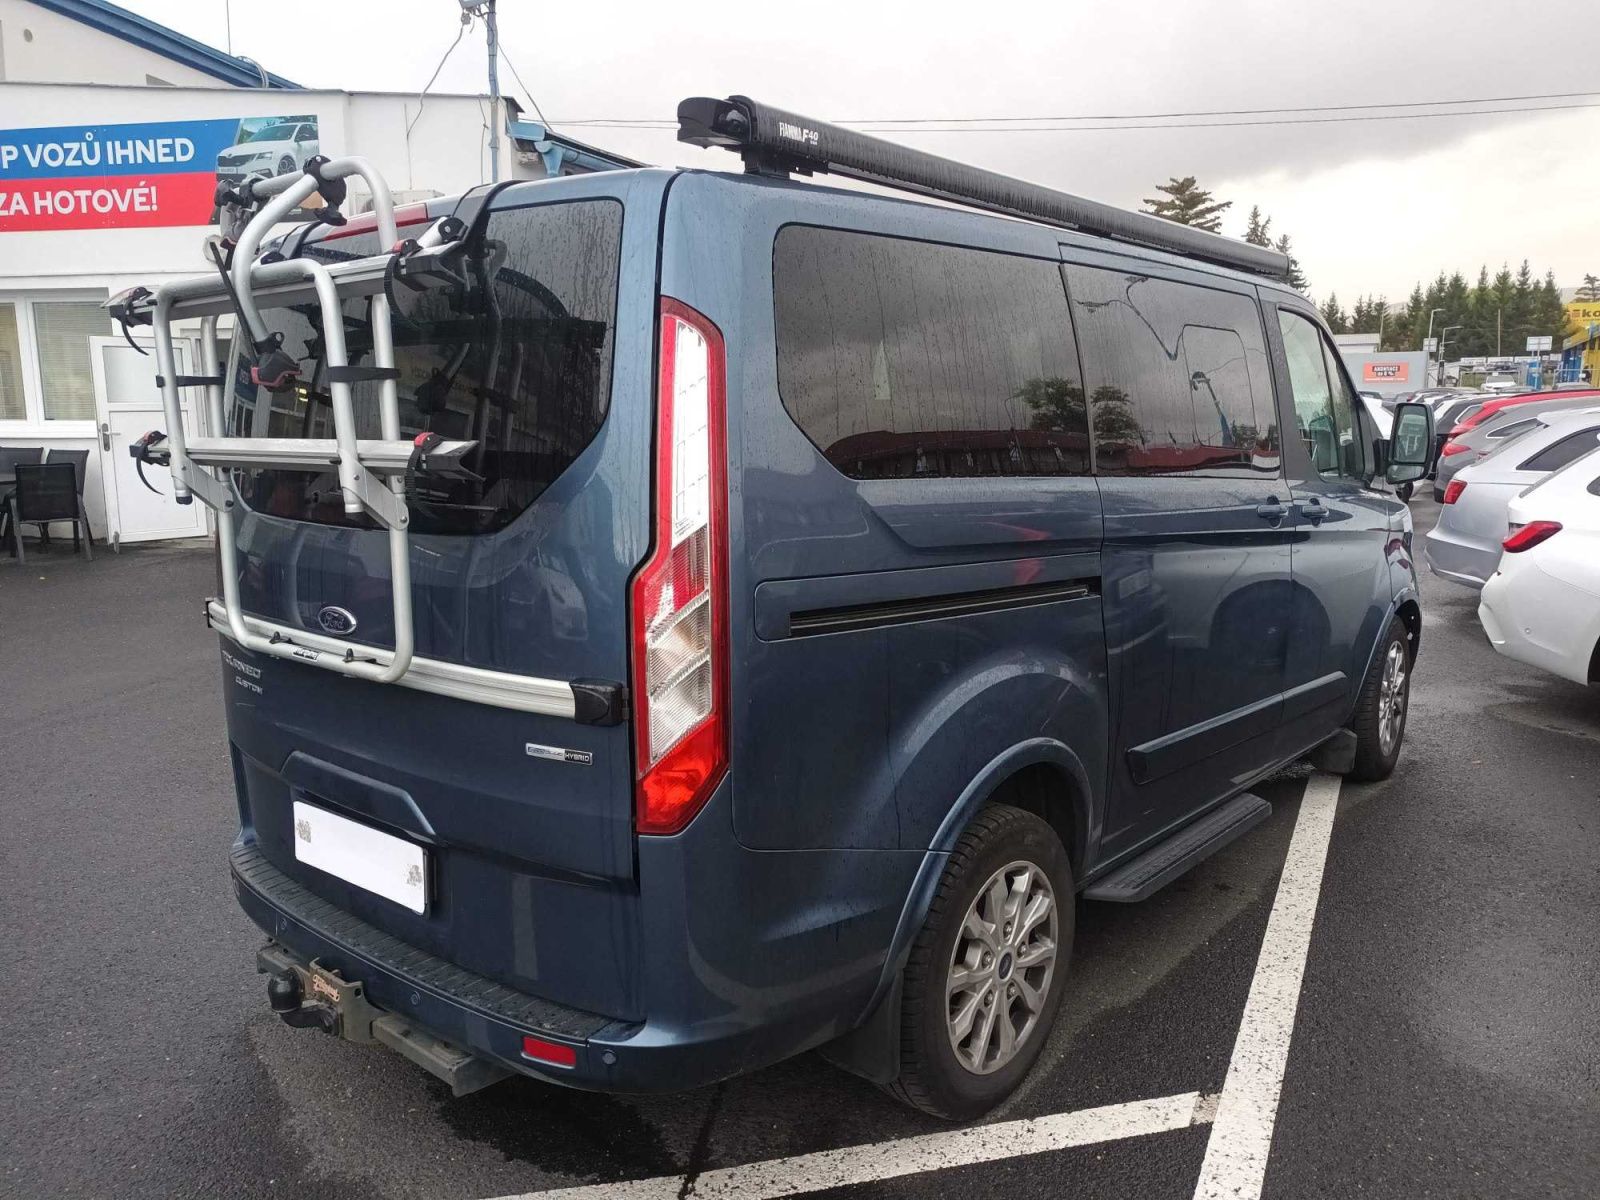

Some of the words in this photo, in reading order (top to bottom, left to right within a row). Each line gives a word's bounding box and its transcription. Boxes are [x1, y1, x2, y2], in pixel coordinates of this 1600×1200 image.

[22, 131, 101, 168] VOZŮ
[106, 137, 195, 165] IHNED
[0, 191, 30, 217] ZA
[33, 181, 158, 216] HOTOVÉ!
[565, 753, 589, 761] HYBRID
